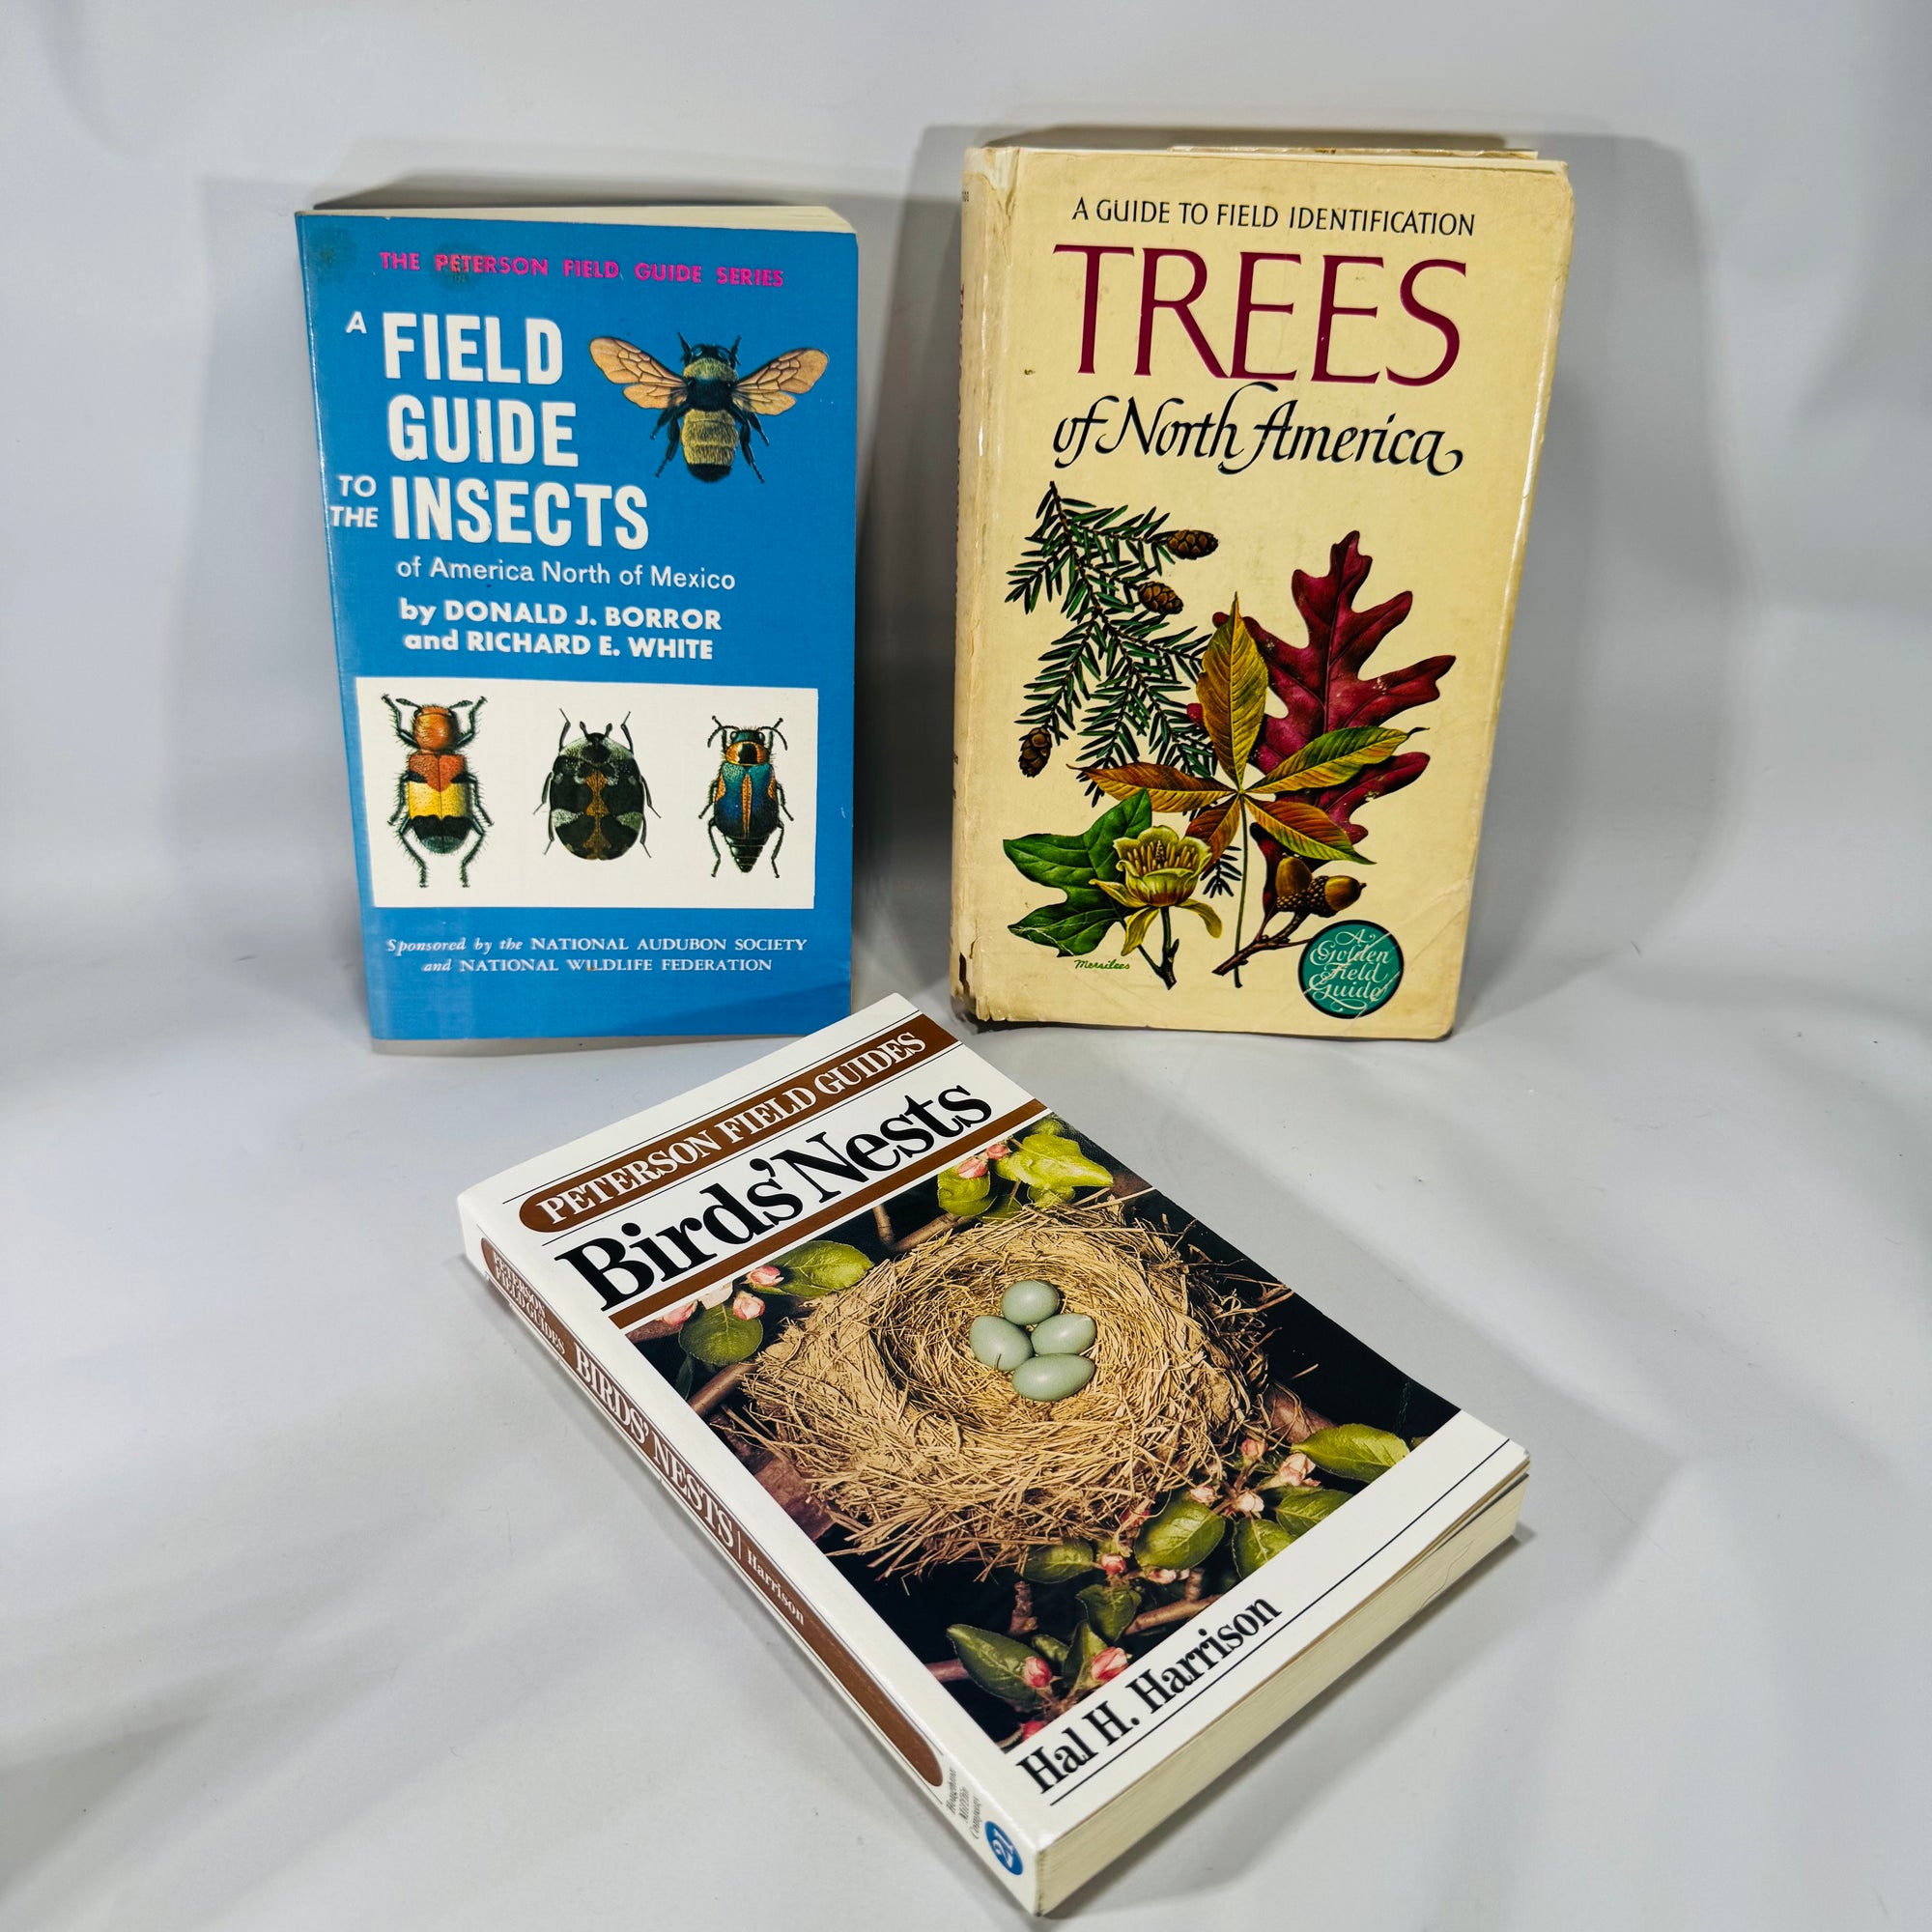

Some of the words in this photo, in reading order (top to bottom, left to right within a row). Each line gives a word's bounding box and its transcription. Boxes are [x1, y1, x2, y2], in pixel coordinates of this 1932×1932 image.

[1071, 196, 1090, 221] A
[1096, 199, 1171, 225] GUIDE
[1179, 202, 1209, 225] TO
[1216, 204, 1279, 229] FIELD
[1289, 208, 1475, 237] IDENTIFICATION
[379, 252, 420, 270] THE
[435, 254, 549, 276] PETERSON
[563, 260, 619, 279] FIELD
[635, 263, 702, 284] GUIDE
[717, 267, 784, 287] SERIES
[1053, 243, 1467, 386] TREES
[346, 312, 367, 333] A
[383, 312, 563, 385] FIELD
[387, 395, 579, 468] GUIDE
[1053, 395, 1120, 469] of
[1095, 382, 1278, 460] North
[1218, 398, 1463, 477] America
[339, 475, 376, 497] TO
[330, 506, 378, 528] THE
[392, 476, 649, 551] INSECTS
[397, 556, 422, 579] of
[429, 557, 535, 582] America
[541, 561, 611, 584] North
[619, 564, 644, 585] of
[649, 566, 736, 590] Mexico
[401, 598, 437, 626] by
[445, 600, 565, 624] DONALD
[575, 605, 597, 627] J.
[606, 606, 722, 631] BORROR
[404, 630, 459, 652] and
[468, 633, 591, 656] RICHARD
[599, 636, 620, 656] E.
[628, 638, 714, 660] WHITE
[387, 937, 467, 956] Sponsored
[474, 938, 493, 953] by
[498, 938, 524, 951] the
[530, 938, 629, 951] NATIONAL
[637, 938, 726, 951] AUDUBON
[734, 939, 808, 951] SOCIETY
[1309, 940, 1392, 966] Golden
[1335, 928, 1376, 946] A
[422, 959, 451, 972] and
[460, 959, 558, 972] NATIONAL
[567, 959, 653, 972] WILDLIFE
[661, 959, 773, 971] FEDERATION
[1320, 961, 1388, 984] Field
[1309, 974, 1388, 1012] Guide
[535, 1131, 724, 1225] PETERSON
[716, 1088, 817, 1144] FIELD
[815, 1032, 926, 1095] GUIDES
[574, 1341, 649, 1444] BIRDS'
[652, 1430, 734, 1547] NESTS
[747, 1547, 805, 1626] Harrison
[1015, 1727, 1098, 1794] Hal
[1082, 1701, 1141, 1746] H.
[1125, 1596, 1283, 1714] Harrison
[992, 1828, 1013, 1869] 21
